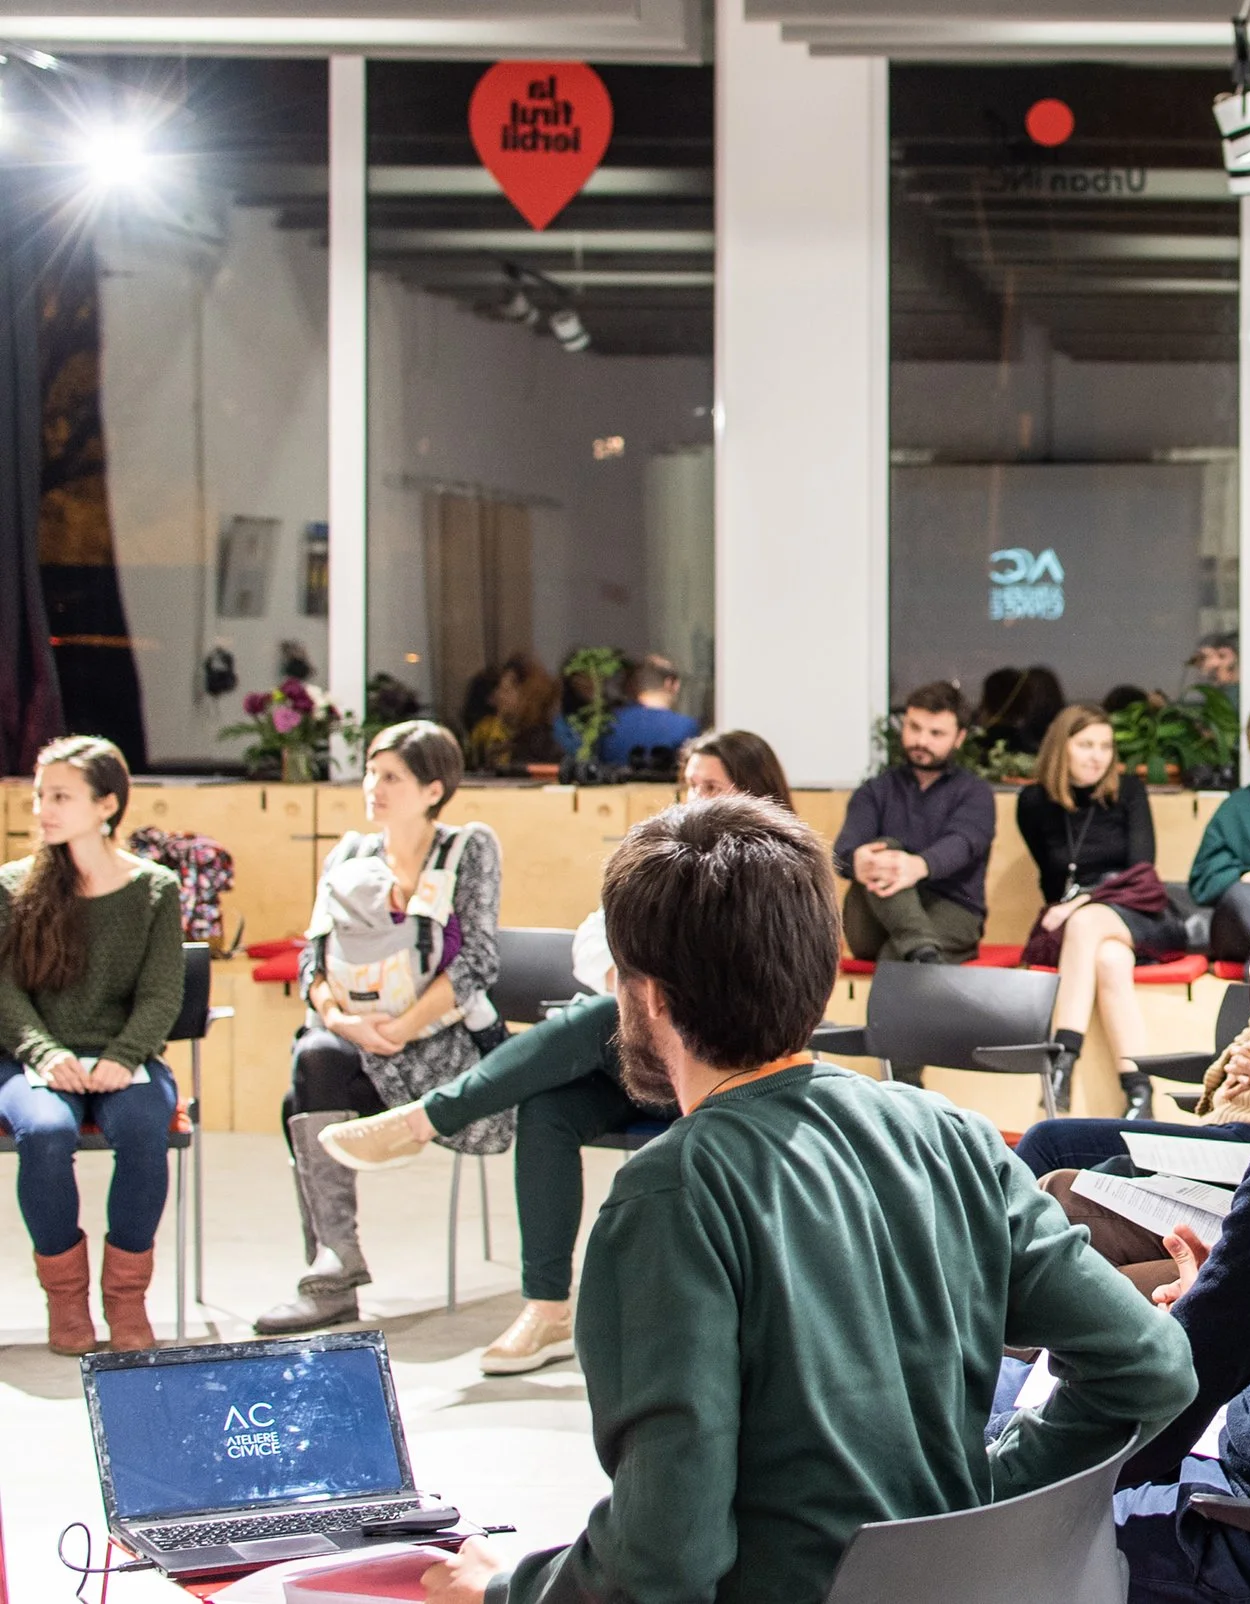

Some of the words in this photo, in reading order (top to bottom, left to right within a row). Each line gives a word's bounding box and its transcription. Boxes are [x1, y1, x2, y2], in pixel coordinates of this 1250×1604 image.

[223, 1402, 275, 1431] AC
[226, 1432, 279, 1447] ATELIERE
[227, 1441, 282, 1459] CIVICE
